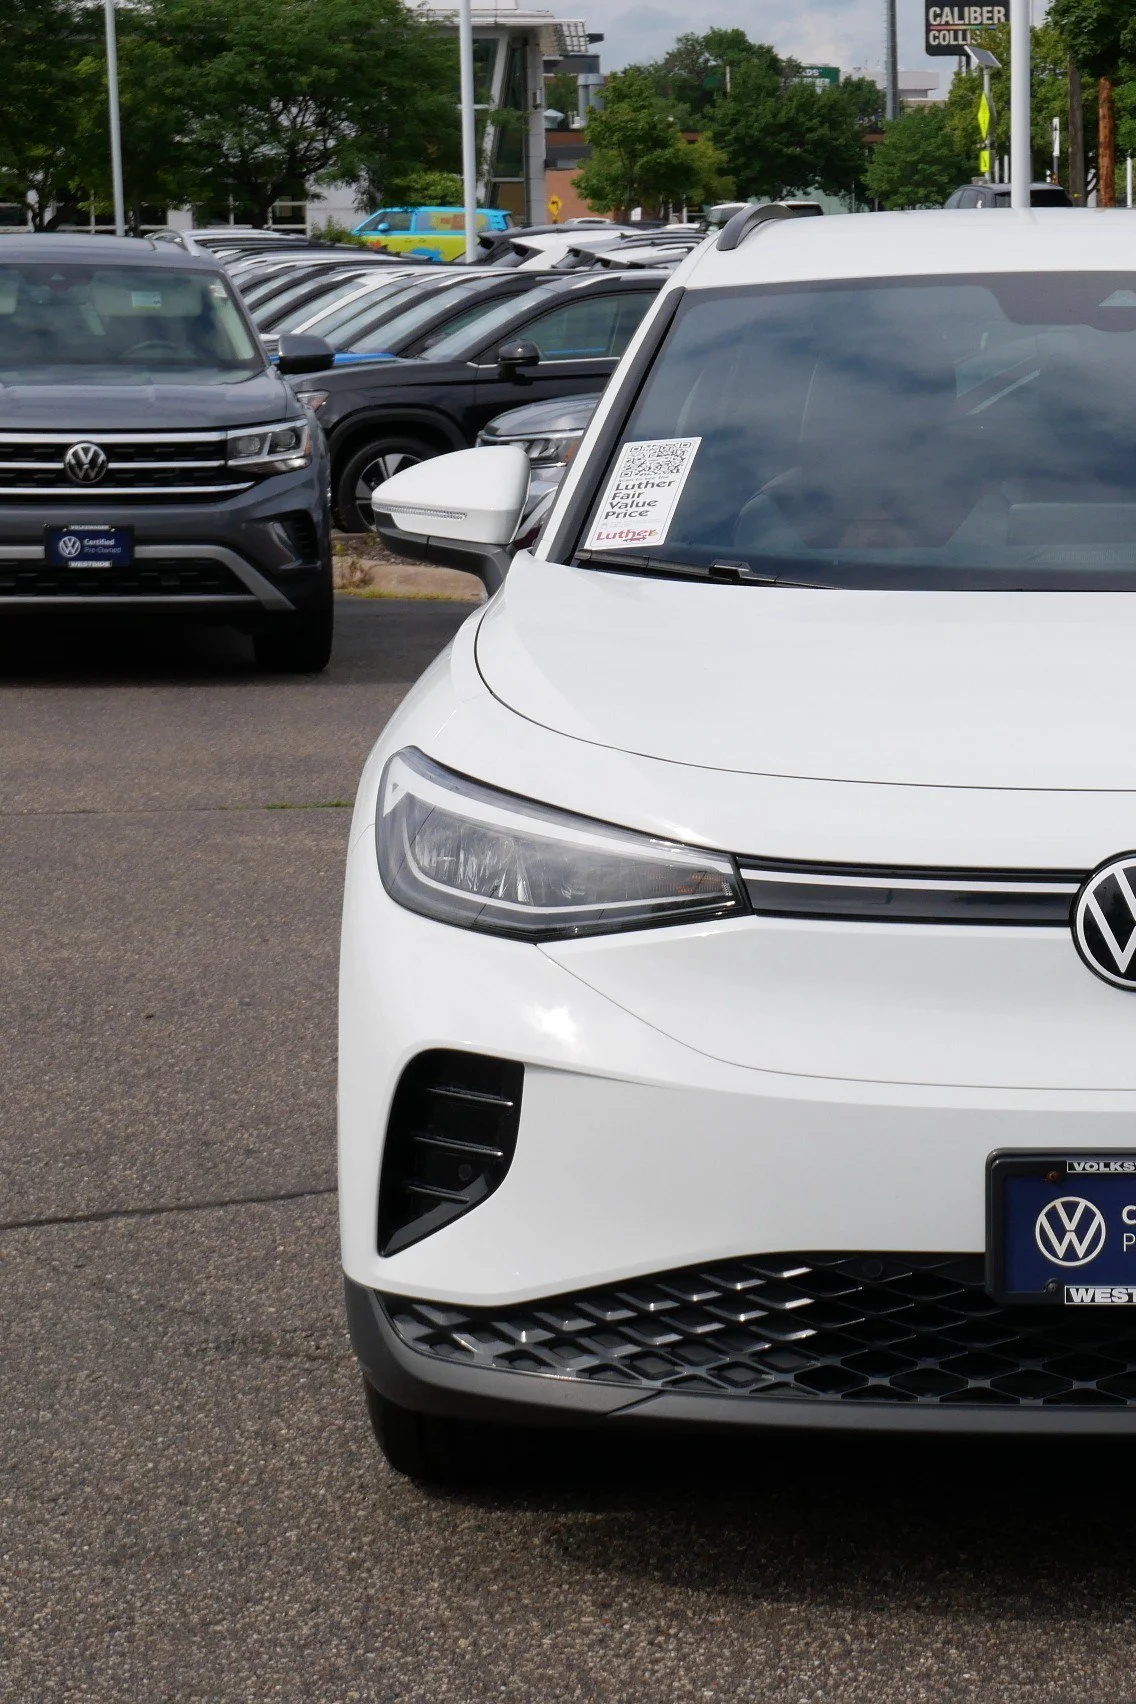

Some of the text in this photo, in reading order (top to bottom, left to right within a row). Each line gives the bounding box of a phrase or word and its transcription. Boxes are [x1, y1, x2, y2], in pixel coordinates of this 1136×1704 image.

[928, 6, 1006, 25] CALIBER
[928, 30, 984, 45] COLLIS
[615, 480, 675, 492] Luther
[611, 490, 645, 501] Fair
[609, 499, 658, 510] Value
[604, 508, 650, 520] Price
[596, 528, 657, 542] Luther
